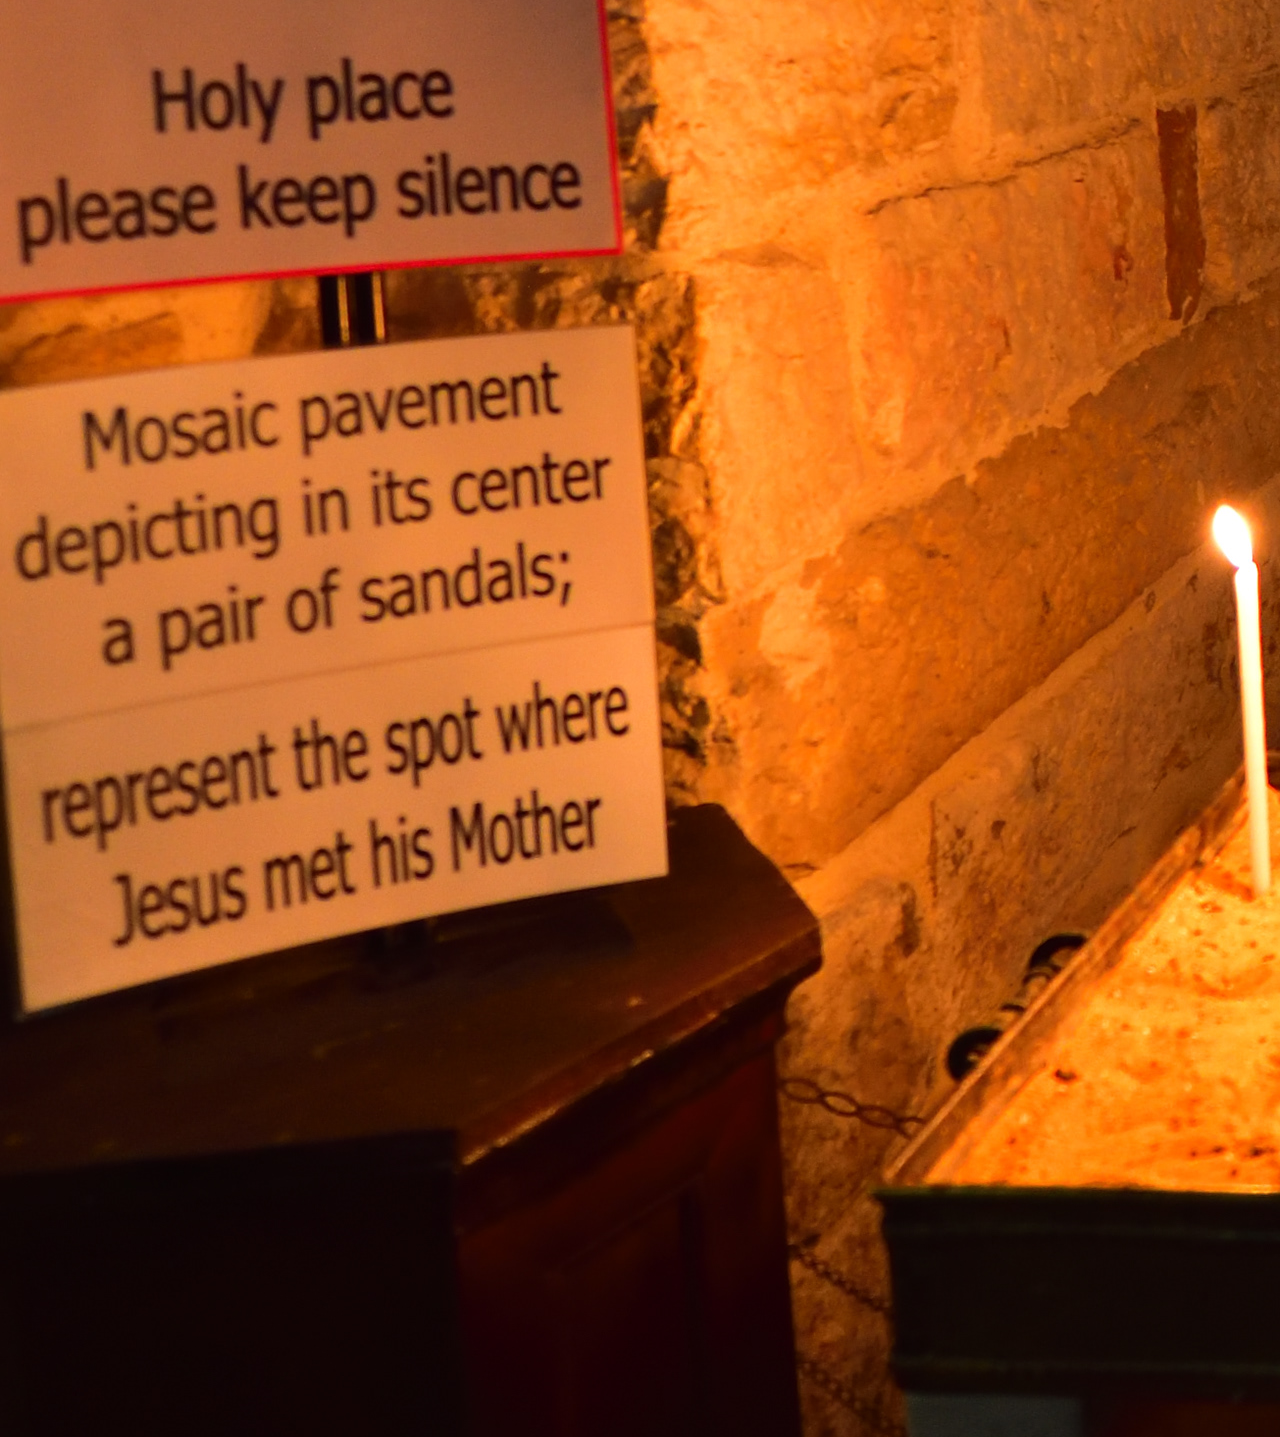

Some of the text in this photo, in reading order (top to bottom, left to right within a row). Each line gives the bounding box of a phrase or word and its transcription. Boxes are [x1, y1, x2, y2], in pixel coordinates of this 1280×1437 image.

[151, 57, 455, 145] Holy place
[17, 151, 582, 264] please keep silence
[82, 360, 562, 471] Mosaic pavement
[14, 452, 611, 585] depicting in its center
[102, 541, 572, 672] a pair of sandals;
[40, 681, 629, 852] represent the spot where
[113, 789, 602, 948] Jesus met his Mother
